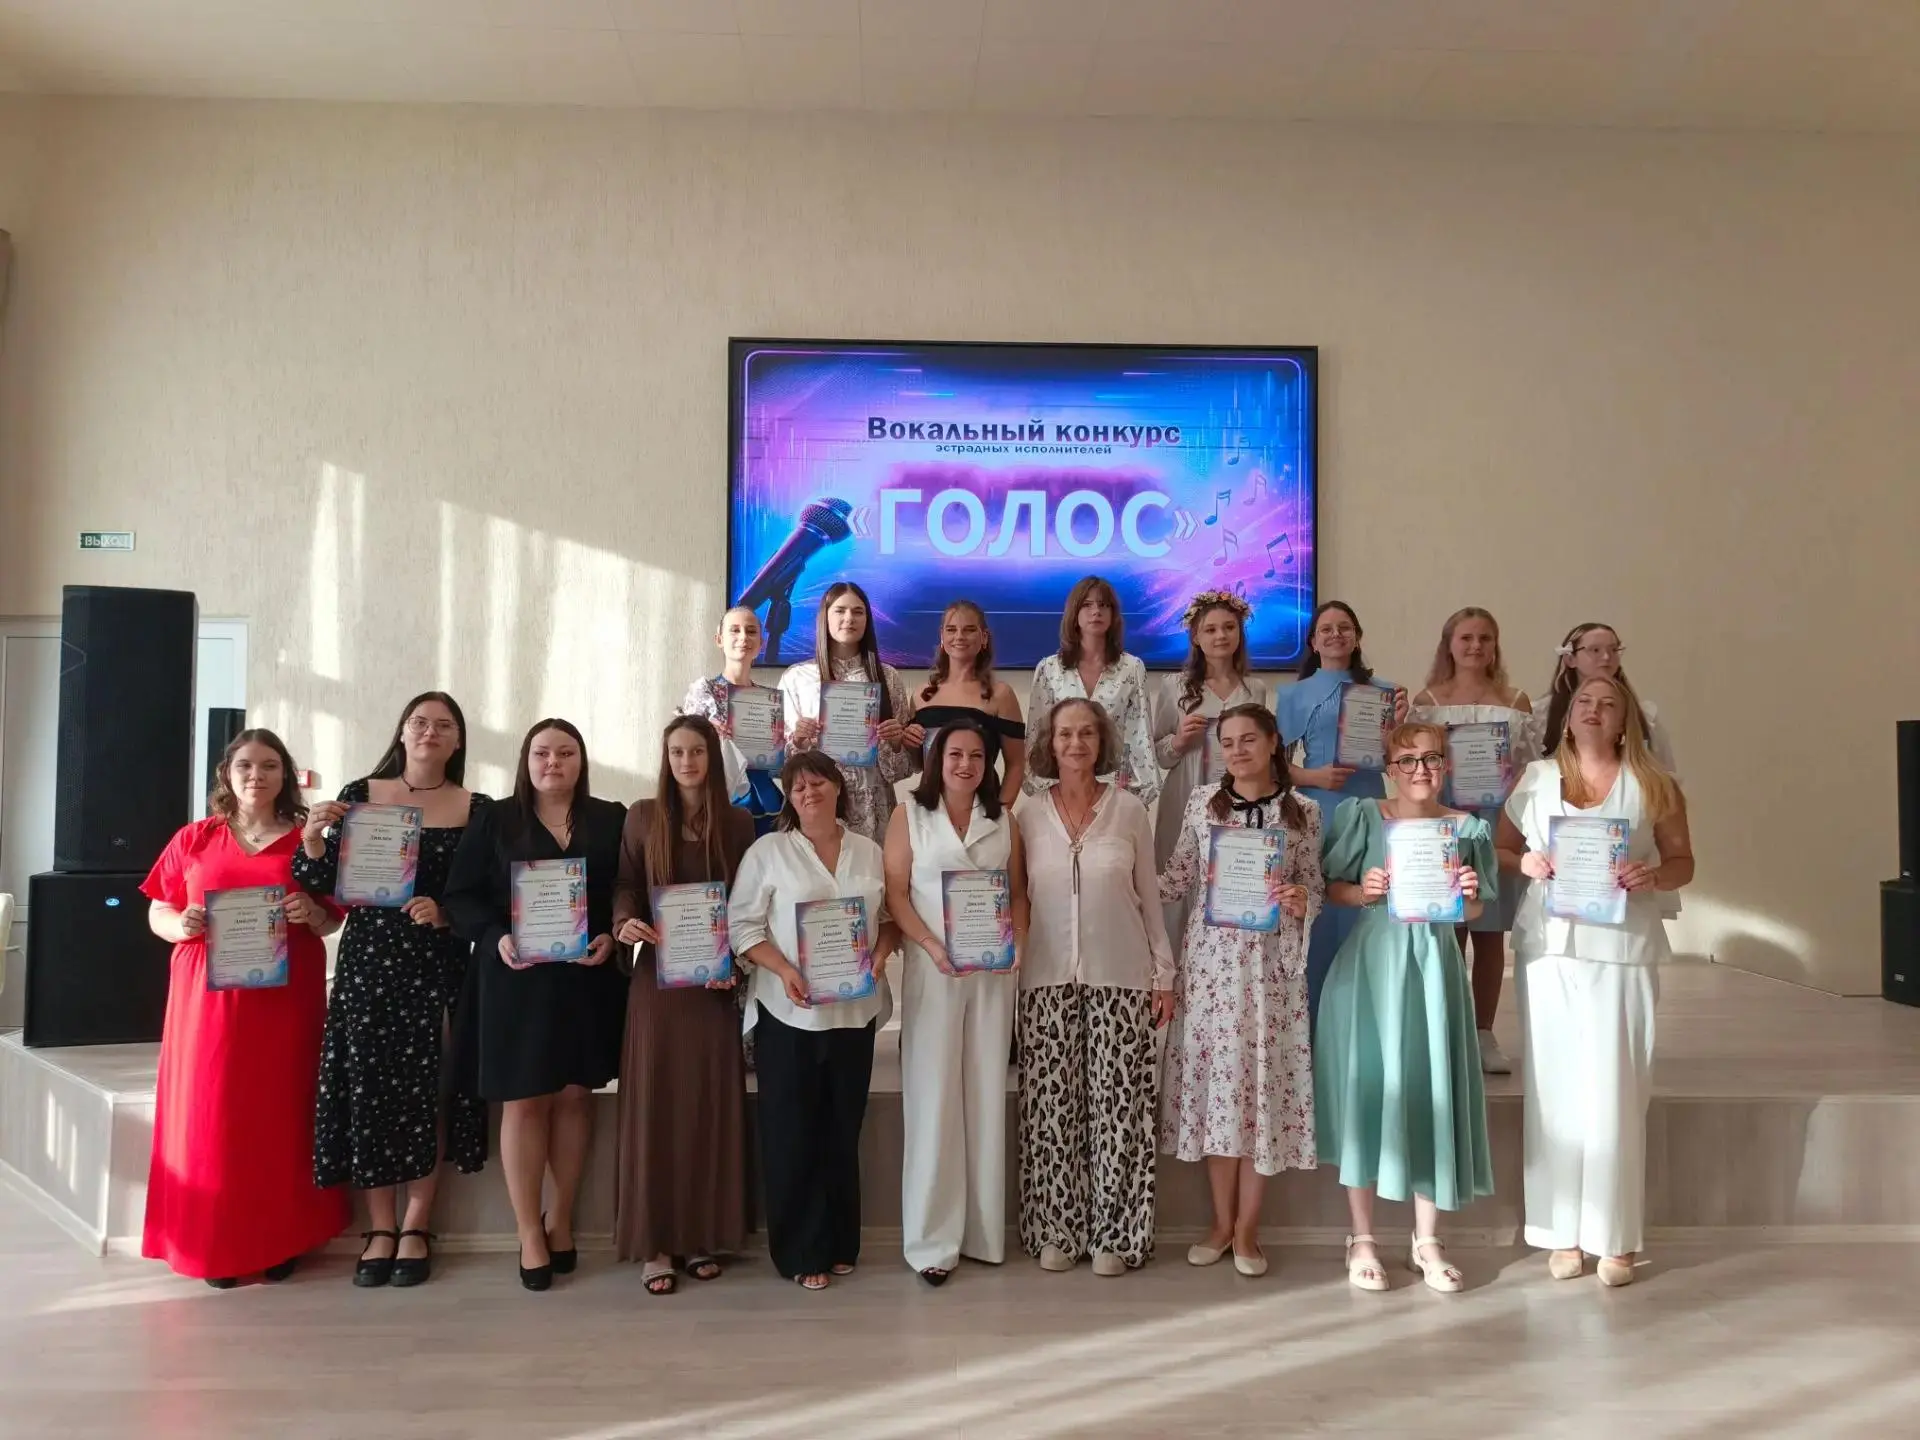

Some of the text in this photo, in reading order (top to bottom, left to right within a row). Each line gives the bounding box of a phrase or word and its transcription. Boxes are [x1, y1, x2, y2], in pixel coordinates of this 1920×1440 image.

[867, 416, 1181, 448] Вокальный конкурс
[935, 443, 1112, 455] эстрадных исполнителей
[846, 488, 1201, 558] «ГОЛОС»
